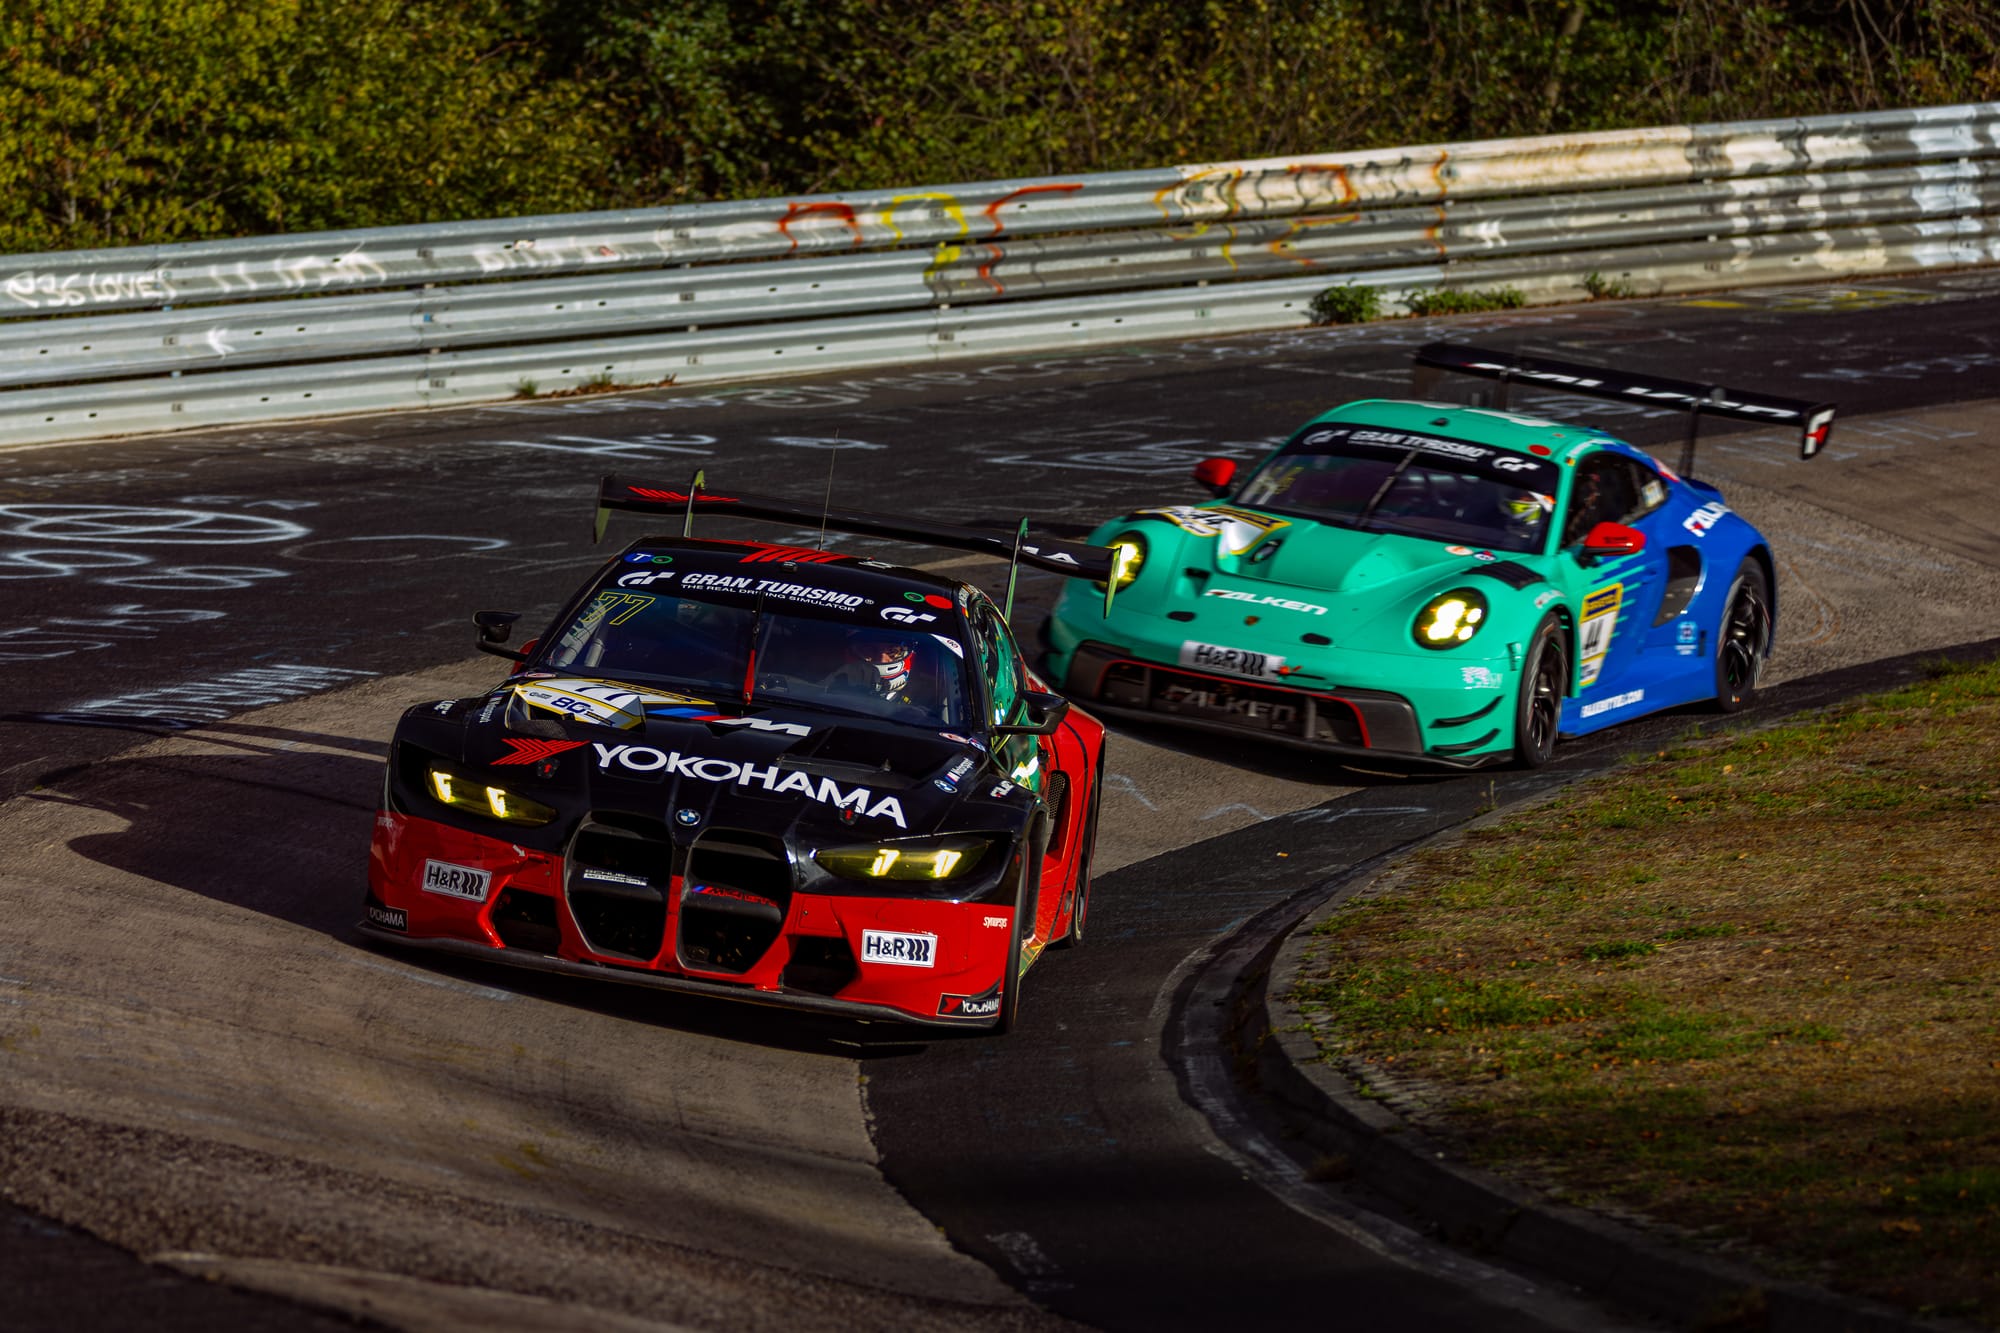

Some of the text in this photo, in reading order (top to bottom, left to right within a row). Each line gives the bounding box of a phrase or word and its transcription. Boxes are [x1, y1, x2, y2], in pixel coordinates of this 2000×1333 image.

[681, 573, 754, 589] GRAN
[581, 592, 657, 626] 77
[707, 584, 737, 593] REAL
[788, 595, 856, 613] SIMULATOR
[1203, 589, 1329, 615] FALKEN
[592, 743, 908, 830] YOKOHAMA
[427, 864, 460, 889] H&R
[867, 936, 905, 957] H&R
